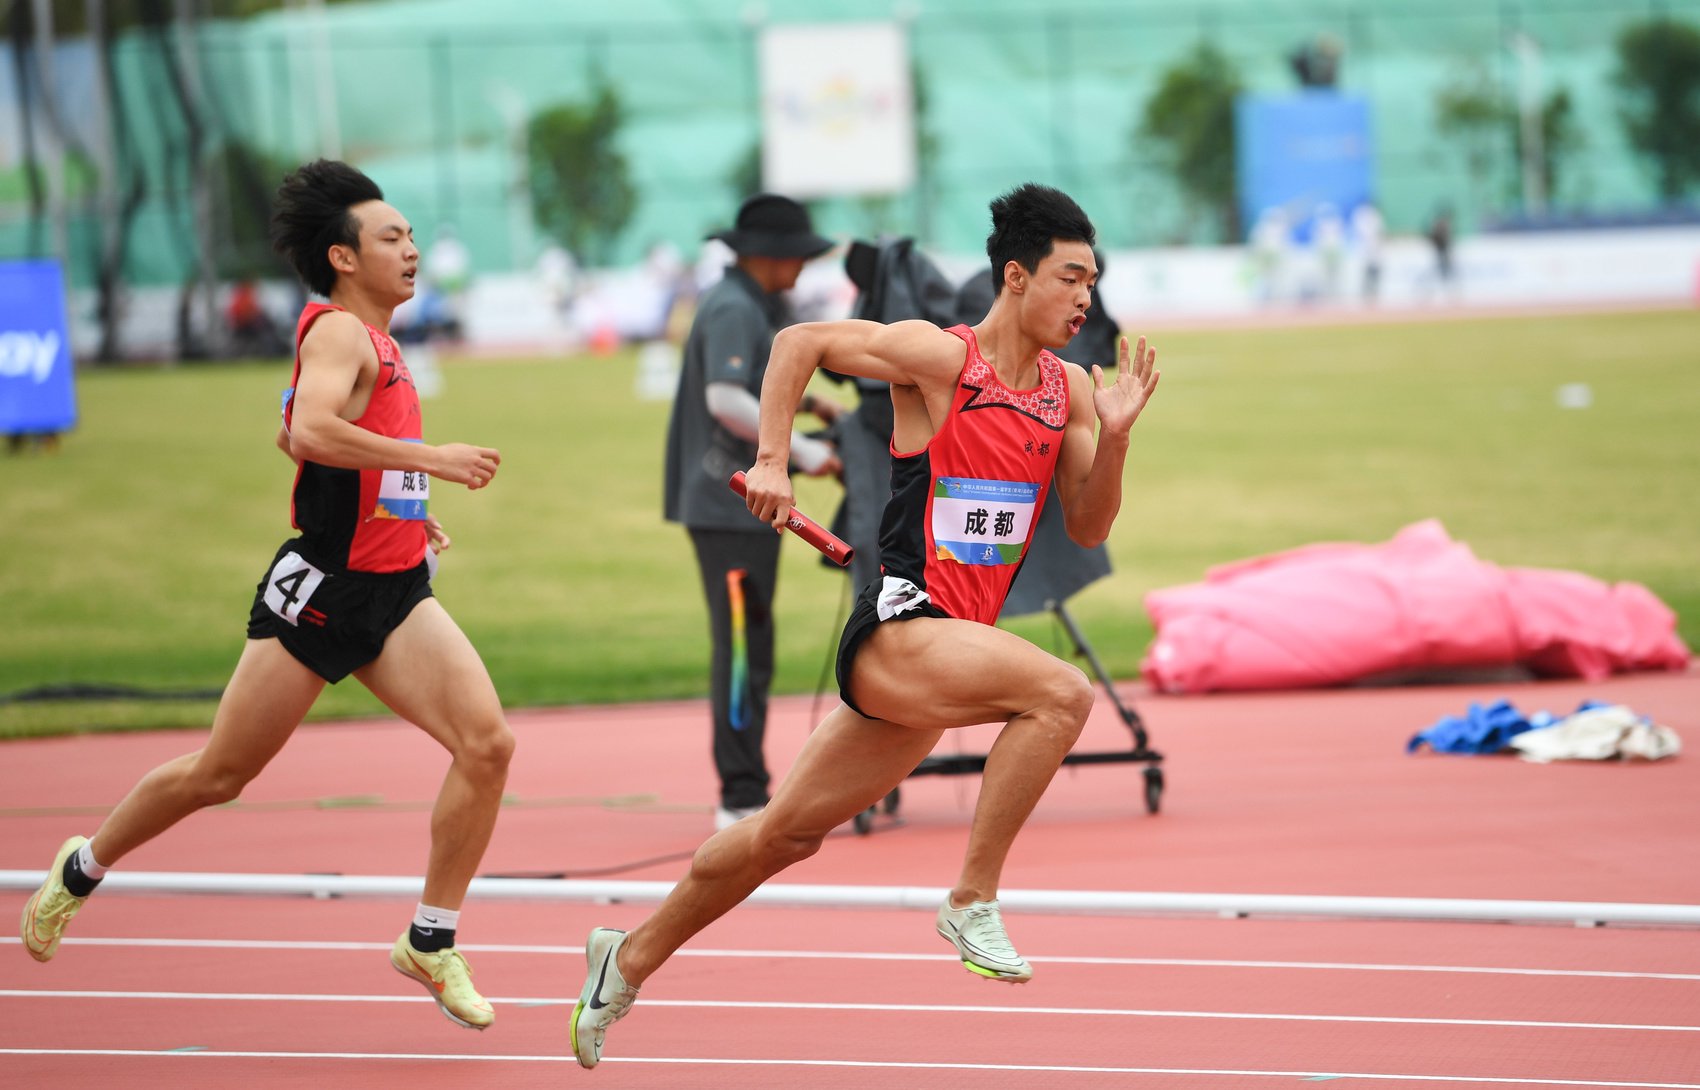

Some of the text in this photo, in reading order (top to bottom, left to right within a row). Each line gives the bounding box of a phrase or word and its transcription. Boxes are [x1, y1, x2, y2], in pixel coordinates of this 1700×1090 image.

[964, 508, 1015, 537] 成都
[826, 542, 835, 552] 4
[274, 568, 311, 616] 4
